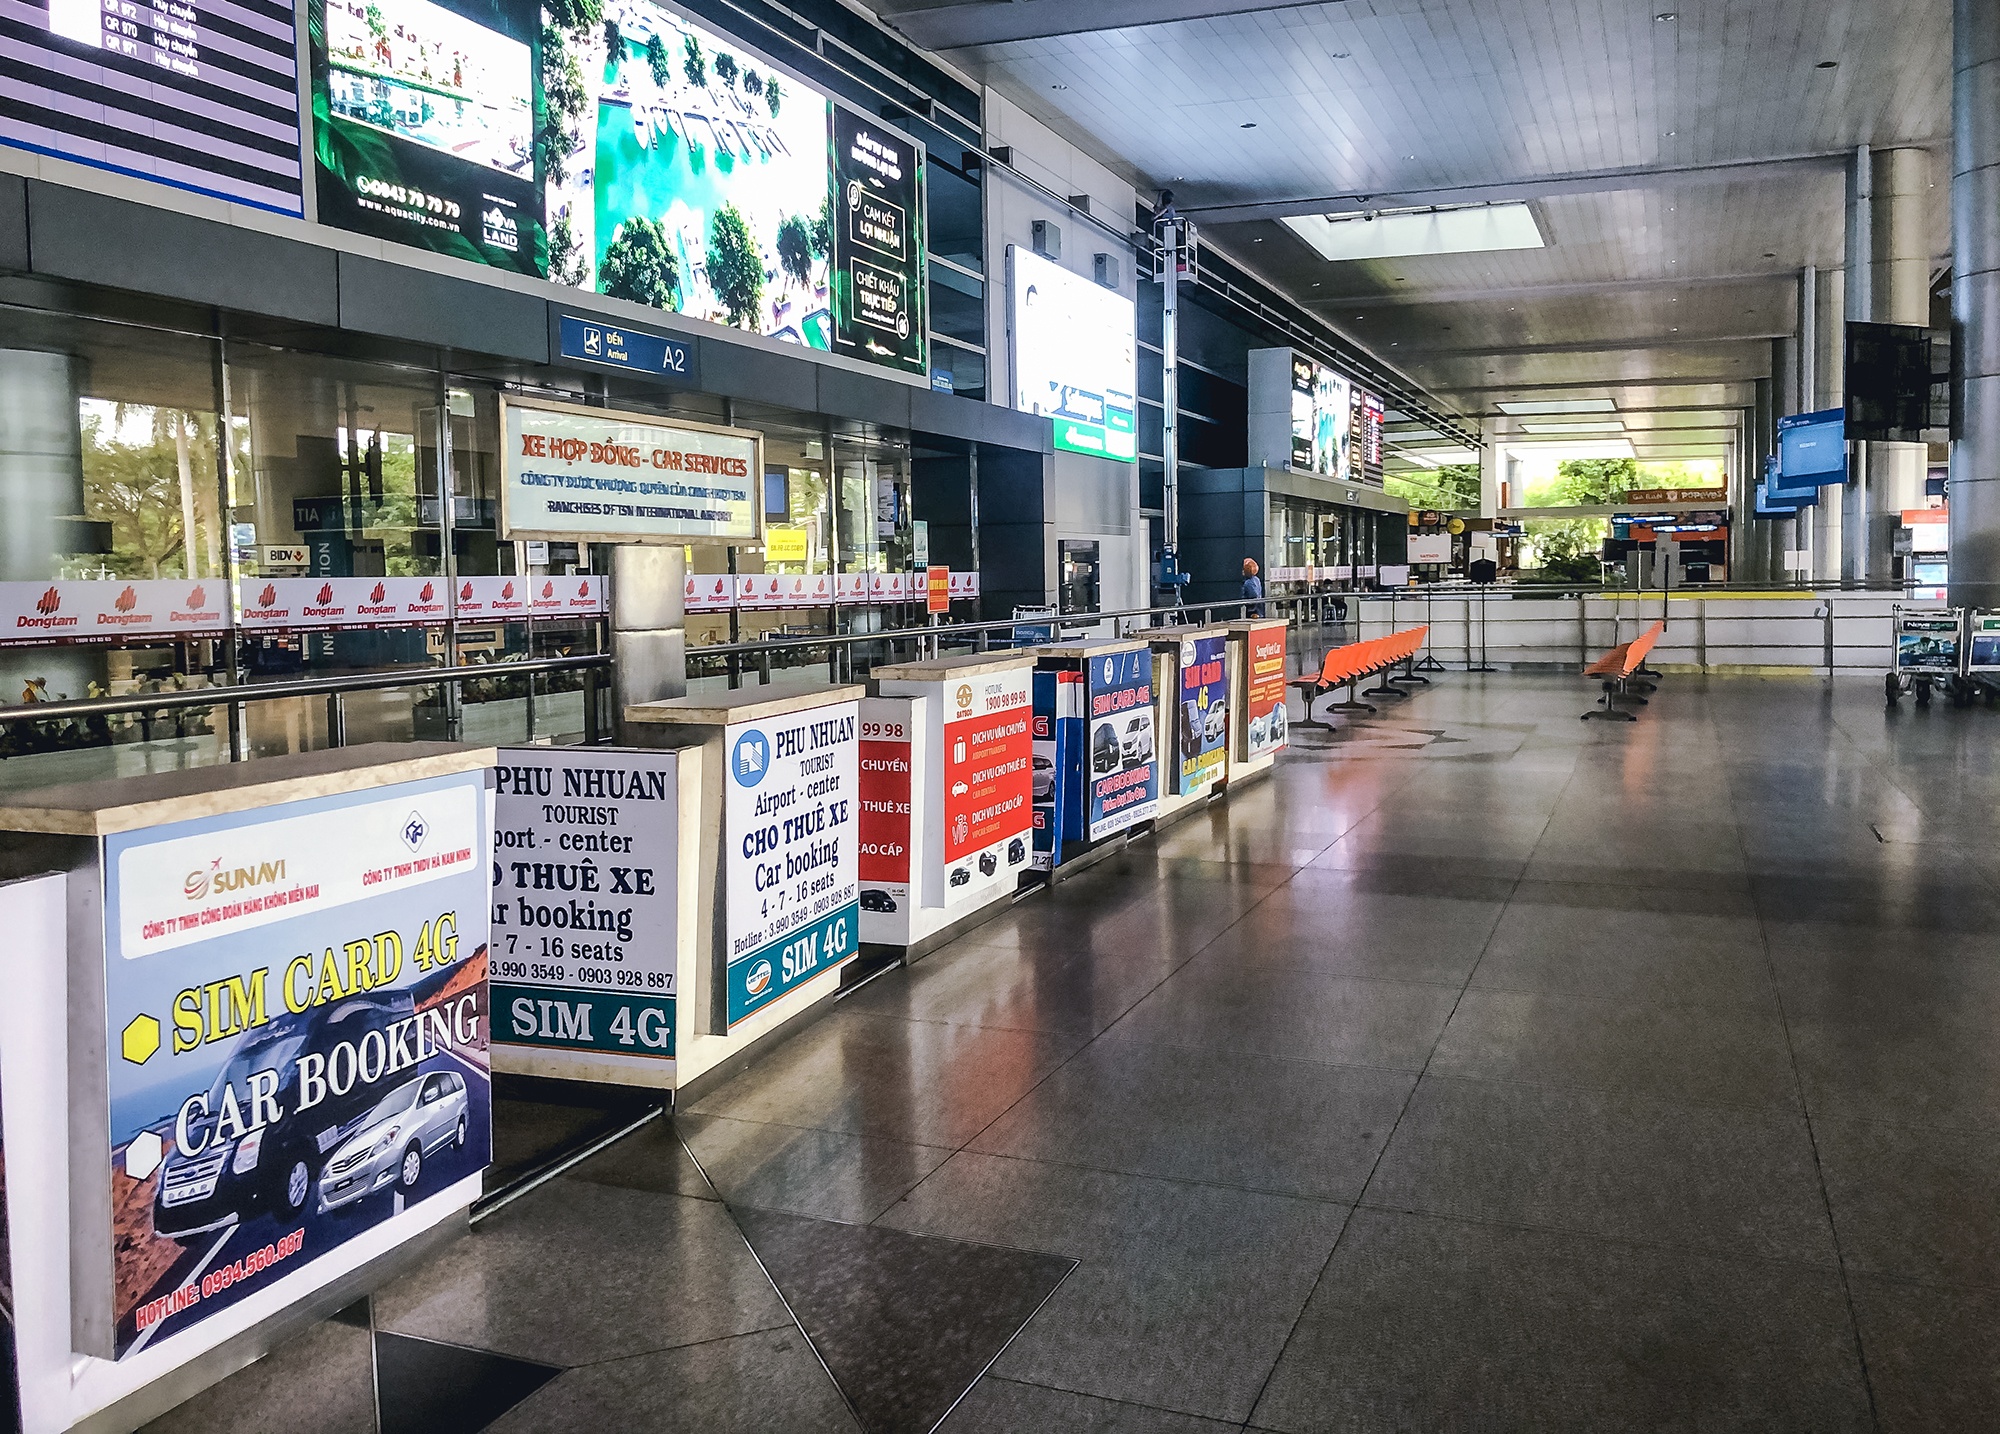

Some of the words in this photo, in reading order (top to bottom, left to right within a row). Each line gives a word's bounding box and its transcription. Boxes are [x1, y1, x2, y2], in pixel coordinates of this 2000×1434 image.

[357, 197, 460, 234] www.aquacity.com.vn
[409, 190, 425, 208] 79
[426, 194, 443, 214] 79
[445, 200, 461, 218] 79
[864, 204, 881, 223] CAM
[881, 211, 896, 228] KẾT
[483, 207, 517, 231] NOVA
[483, 228, 518, 246] LAND
[856, 271, 878, 290] CHIẾT
[606, 331, 624, 347] ĐẾN
[607, 349, 628, 362] Arrival
[662, 345, 686, 373] A2
[522, 434, 546, 457] XE
[549, 437, 587, 466] HỢP
[590, 436, 641, 468] ĐỒNG
[652, 449, 683, 471] CAR
[684, 452, 748, 477] SERVICES
[296, 508, 320, 523] TIA
[270, 550, 292, 561] BIDV
[243, 608, 289, 619] Dongtam
[303, 606, 345, 618] Dongtam
[357, 605, 397, 616] Dongtam
[408, 603, 444, 613] Dongtam
[492, 600, 522, 612] Dongtam
[533, 600, 562, 609] Dongtam
[570, 599, 596, 608] Dongtam
[16, 616, 78, 629] Dongtam
[97, 613, 153, 625] Dongtam
[170, 611, 220, 622] Dongtam
[986, 696, 1001, 710] 1900
[1001, 694, 1010, 707] 98
[1010, 692, 1018, 706] 99
[1018, 690, 1027, 703] 98
[1093, 693, 1111, 716] SIM
[1111, 688, 1136, 711] CARD
[1136, 685, 1150, 704] 4G
[1198, 685, 1208, 711] 4G
[776, 726, 806, 759] PHU
[810, 716, 855, 750] NHUAN
[862, 722, 881, 737] 99
[884, 723, 904, 738] 98
[972, 732, 987, 747] DỊCH
[986, 730, 995, 744] VỤ
[799, 752, 835, 777] TOURIST
[861, 757, 908, 773] CHUYỂN
[972, 771, 987, 786] DỊCH
[986, 768, 995, 781] VỤ
[995, 763, 1007, 777] CHO
[1006, 757, 1020, 773] THUÊ
[1020, 757, 1027, 769] XE
[494, 766, 552, 796] PHU
[563, 768, 667, 801] NHUAN
[1112, 765, 1150, 793] BOOKING
[755, 785, 796, 817] Airport
[807, 775, 840, 799] center
[864, 800, 894, 815] THUÊ
[895, 801, 910, 814] XE
[972, 811, 987, 826] DỊCH
[986, 808, 995, 820] VỤ
[994, 803, 1002, 815] XE
[1002, 799, 1013, 813] CAO
[1012, 793, 1024, 811] CẤP
[542, 804, 619, 826] TOURIST
[743, 824, 779, 859] CHO
[782, 801, 825, 845] THUÊ
[829, 799, 849, 828] XE
[559, 830, 633, 853] center
[880, 841, 904, 857] CẤP
[214, 859, 286, 894] SUNAVI
[363, 869, 382, 886] CÔNG
[383, 867, 393, 881] TY
[441, 852, 455, 866] NAM
[511, 857, 600, 893] THUÊ
[609, 867, 656, 896] XE
[755, 862, 782, 892] Car
[786, 836, 839, 881] booking
[761, 899, 768, 919] 4
[779, 891, 786, 911] 7
[797, 881, 808, 904] 16
[810, 872, 835, 897] seats
[143, 920, 165, 940] CÔNG
[167, 917, 178, 933] TY
[201, 907, 221, 926] CÔNG
[243, 896, 263, 915] HÀNG
[264, 890, 287, 910] KHÔNG
[305, 884, 320, 901] NAM
[517, 896, 633, 943] booking
[734, 930, 763, 955] Hotline
[769, 915, 789, 937] 3.990
[791, 906, 808, 929] 3549
[813, 895, 830, 917] 0903
[830, 889, 842, 909] 928
[843, 883, 855, 900] 887
[506, 934, 518, 954] 7
[541, 936, 564, 958] 16
[571, 941, 624, 962] seats
[781, 930, 819, 985] SIM
[823, 917, 848, 960] 4G
[172, 966, 270, 1056] SIM
[283, 928, 403, 1016] CARD
[413, 910, 459, 974] 4G
[489, 961, 527, 978] 3.990
[531, 964, 565, 981] 3549
[578, 967, 613, 985] 0903
[617, 970, 643, 987] 928
[647, 972, 674, 989] 887
[512, 997, 594, 1042] SIM
[609, 1006, 671, 1049] 4G
[174, 1067, 285, 1158] CAR
[293, 991, 480, 1116] BOOKING
[136, 1283, 200, 1332] HOTLINE:
[201, 1227, 305, 1299] 0934.560.887
